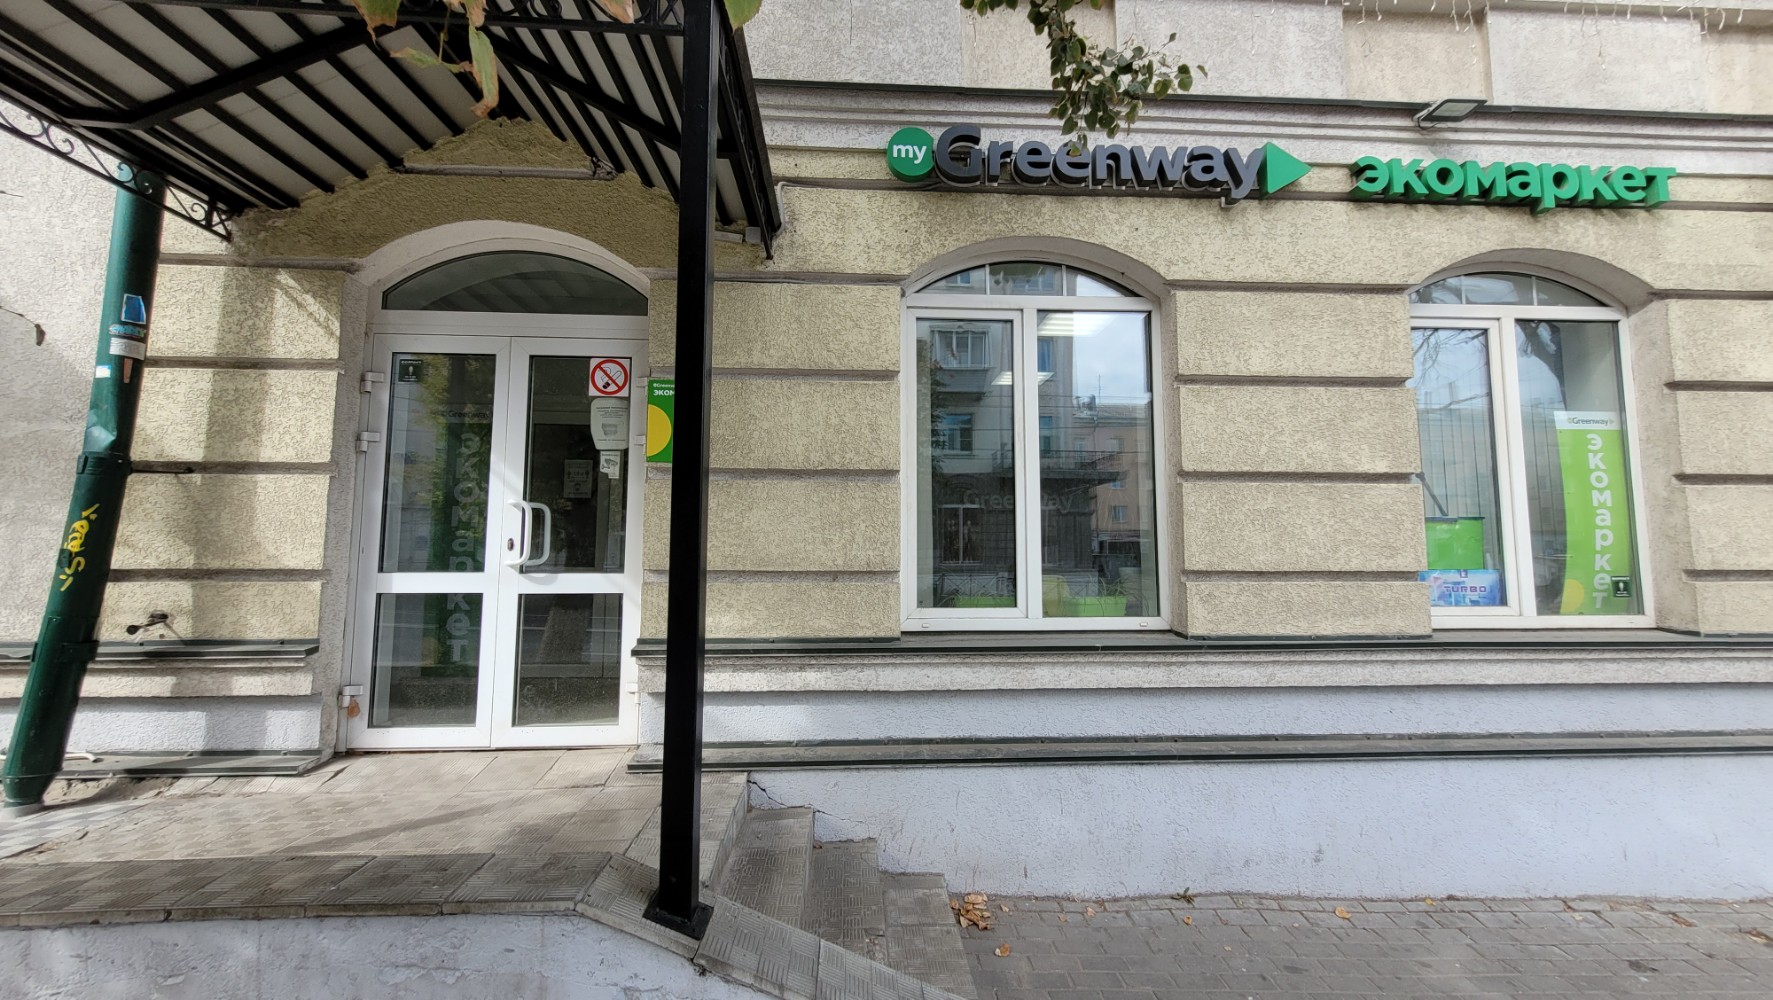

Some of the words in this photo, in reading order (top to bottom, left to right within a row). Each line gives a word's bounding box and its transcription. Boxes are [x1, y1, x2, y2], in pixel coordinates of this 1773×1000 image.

[892, 142, 927, 165] my
[936, 124, 1262, 200] Greenway
[1352, 155, 1677, 213] экомаркет
[1443, 585, 1487, 593] TURBO
